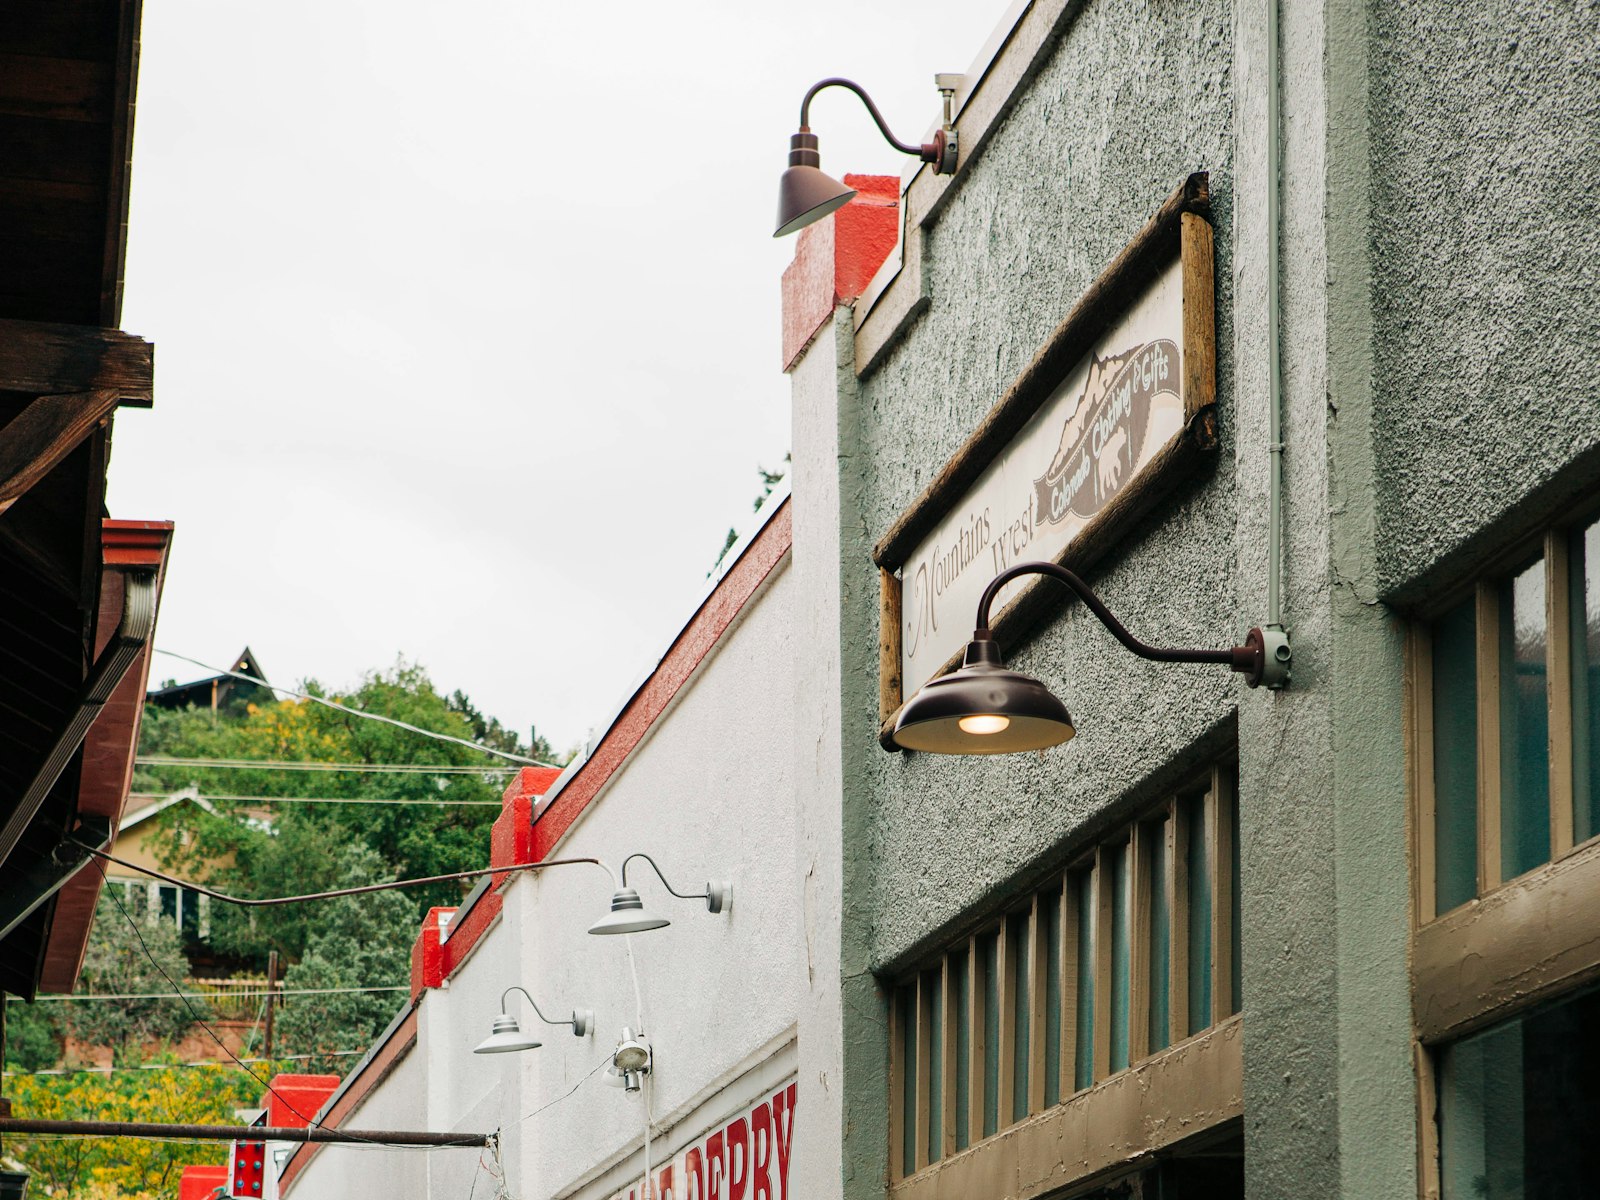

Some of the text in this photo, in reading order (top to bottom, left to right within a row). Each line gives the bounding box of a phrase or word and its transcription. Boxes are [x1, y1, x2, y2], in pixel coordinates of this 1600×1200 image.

[1051, 343, 1169, 519] Colorado Clothing & Gifts
[907, 505, 990, 658] Mountains
[991, 493, 1034, 598] West
